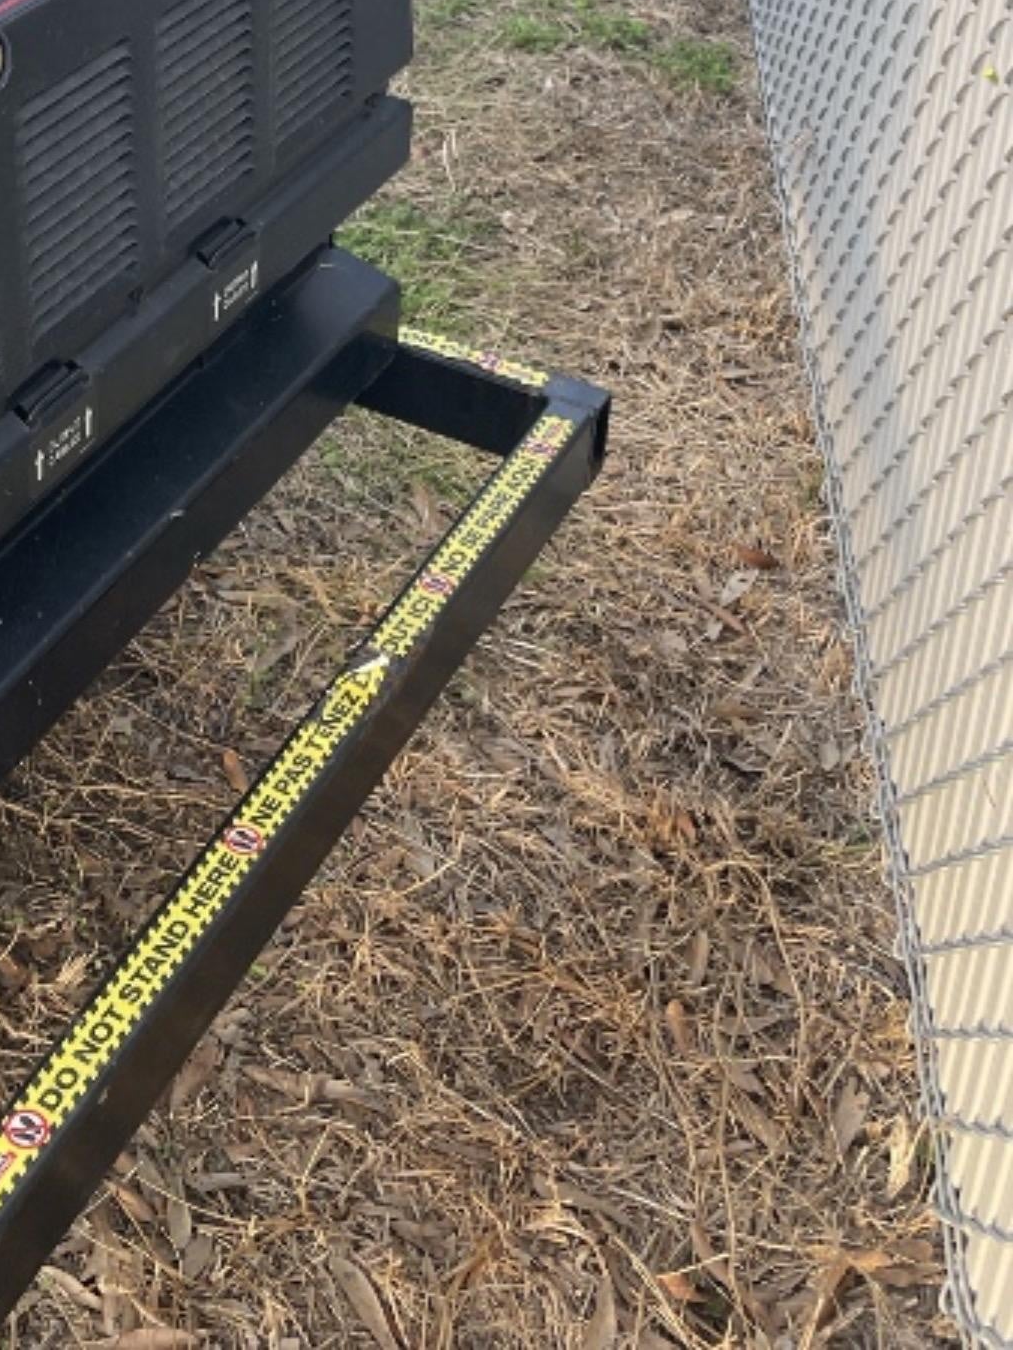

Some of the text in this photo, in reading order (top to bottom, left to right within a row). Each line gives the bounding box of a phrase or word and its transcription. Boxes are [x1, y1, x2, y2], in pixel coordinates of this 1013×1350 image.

[250, 794, 282, 828] NE
[273, 753, 312, 795] PAS
[36, 851, 243, 1112] DO NOT STAND HERE
